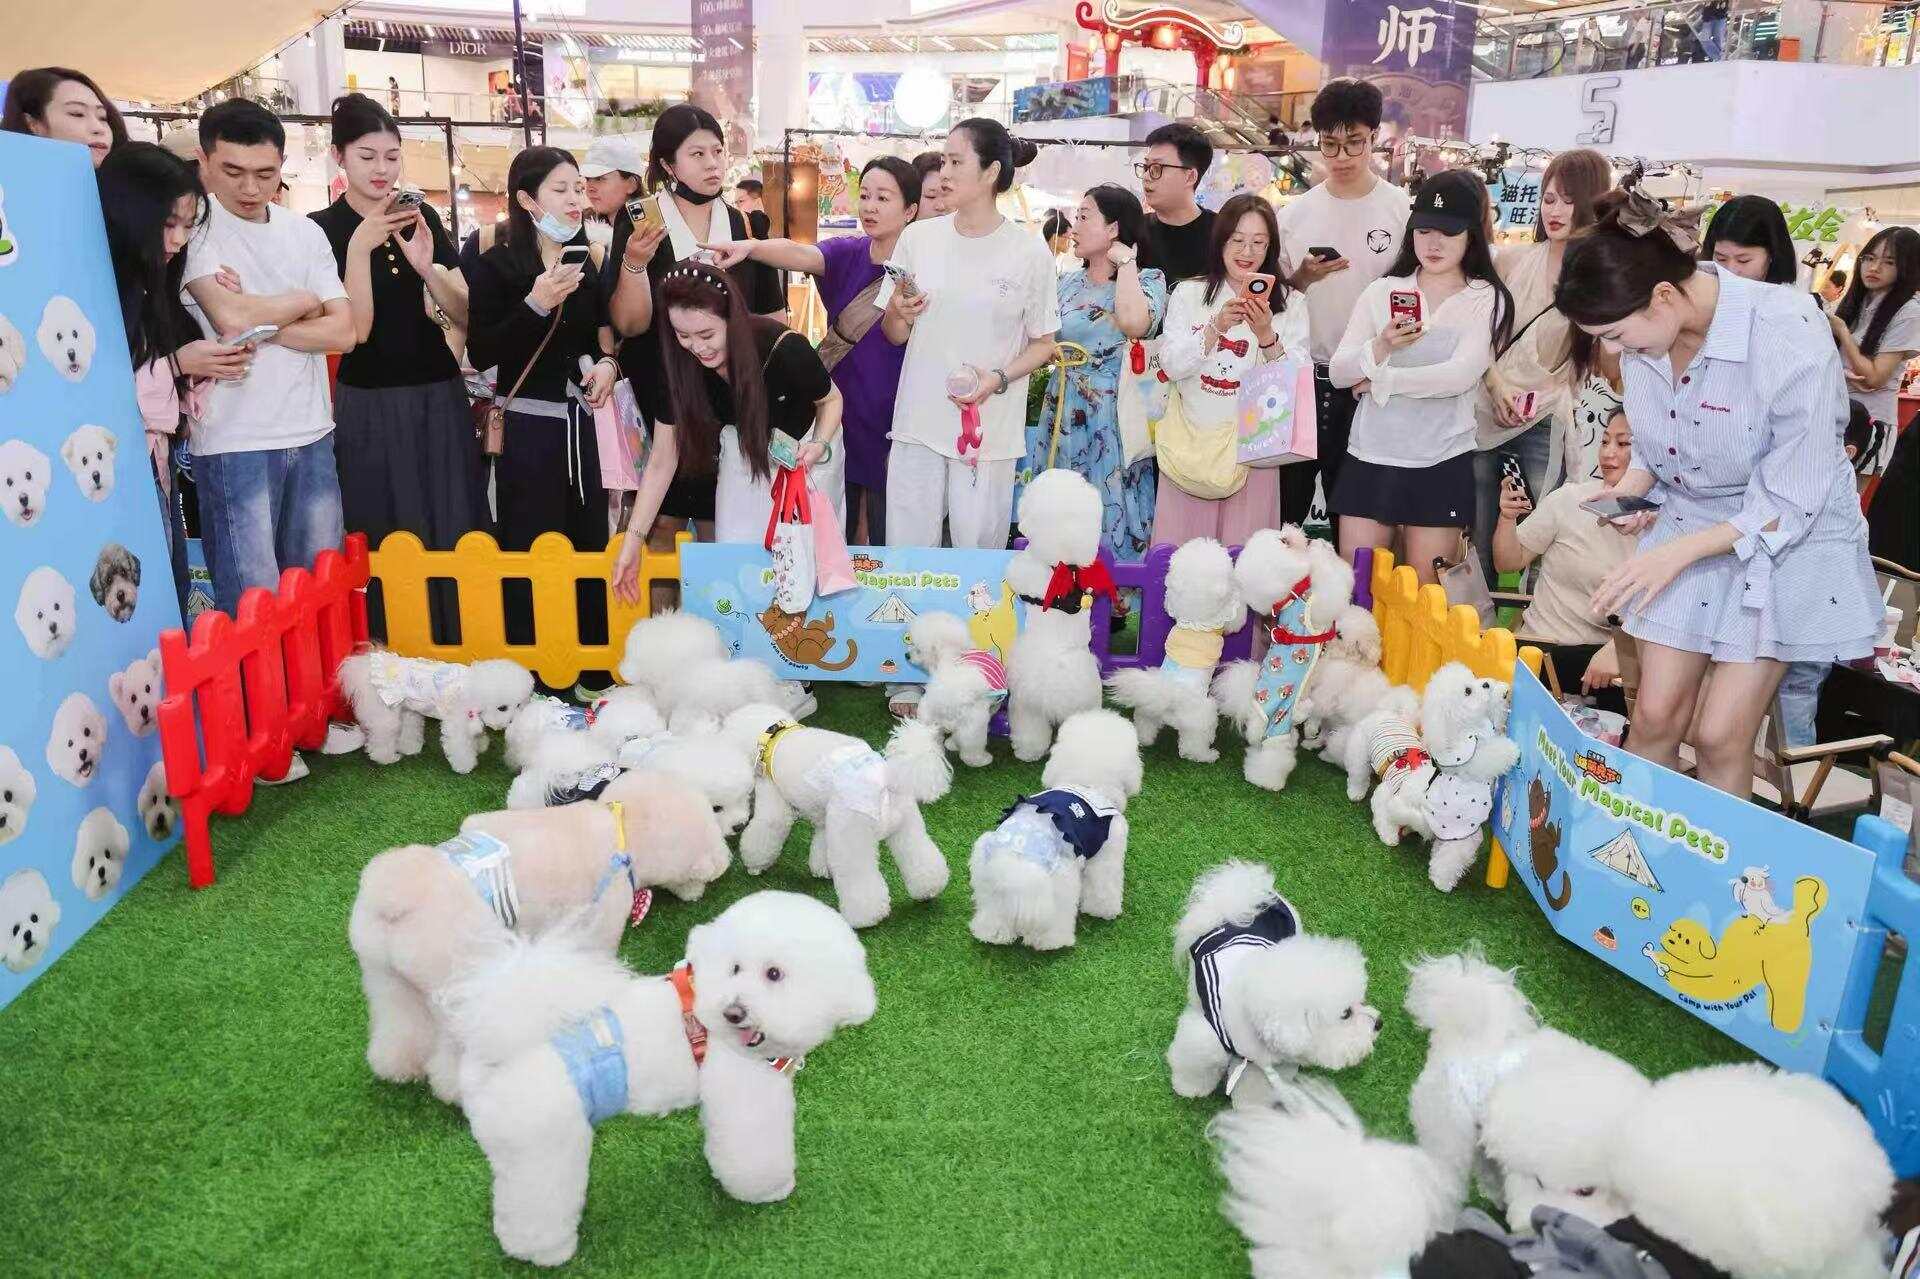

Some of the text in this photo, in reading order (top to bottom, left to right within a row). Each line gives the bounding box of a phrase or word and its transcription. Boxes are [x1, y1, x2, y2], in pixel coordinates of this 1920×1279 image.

[449, 41, 488, 56] DIOR
[1371, 4, 1438, 68] 师
[1575, 76, 1622, 145] 5
[854, 571, 960, 590] Magical Pets
[1580, 776, 1665, 832] Magical
[1668, 817, 1726, 860] Pets
[1678, 993, 1702, 1009] Camp
[1703, 1002, 1724, 1012] with
[1724, 1000, 1743, 1011] Your
